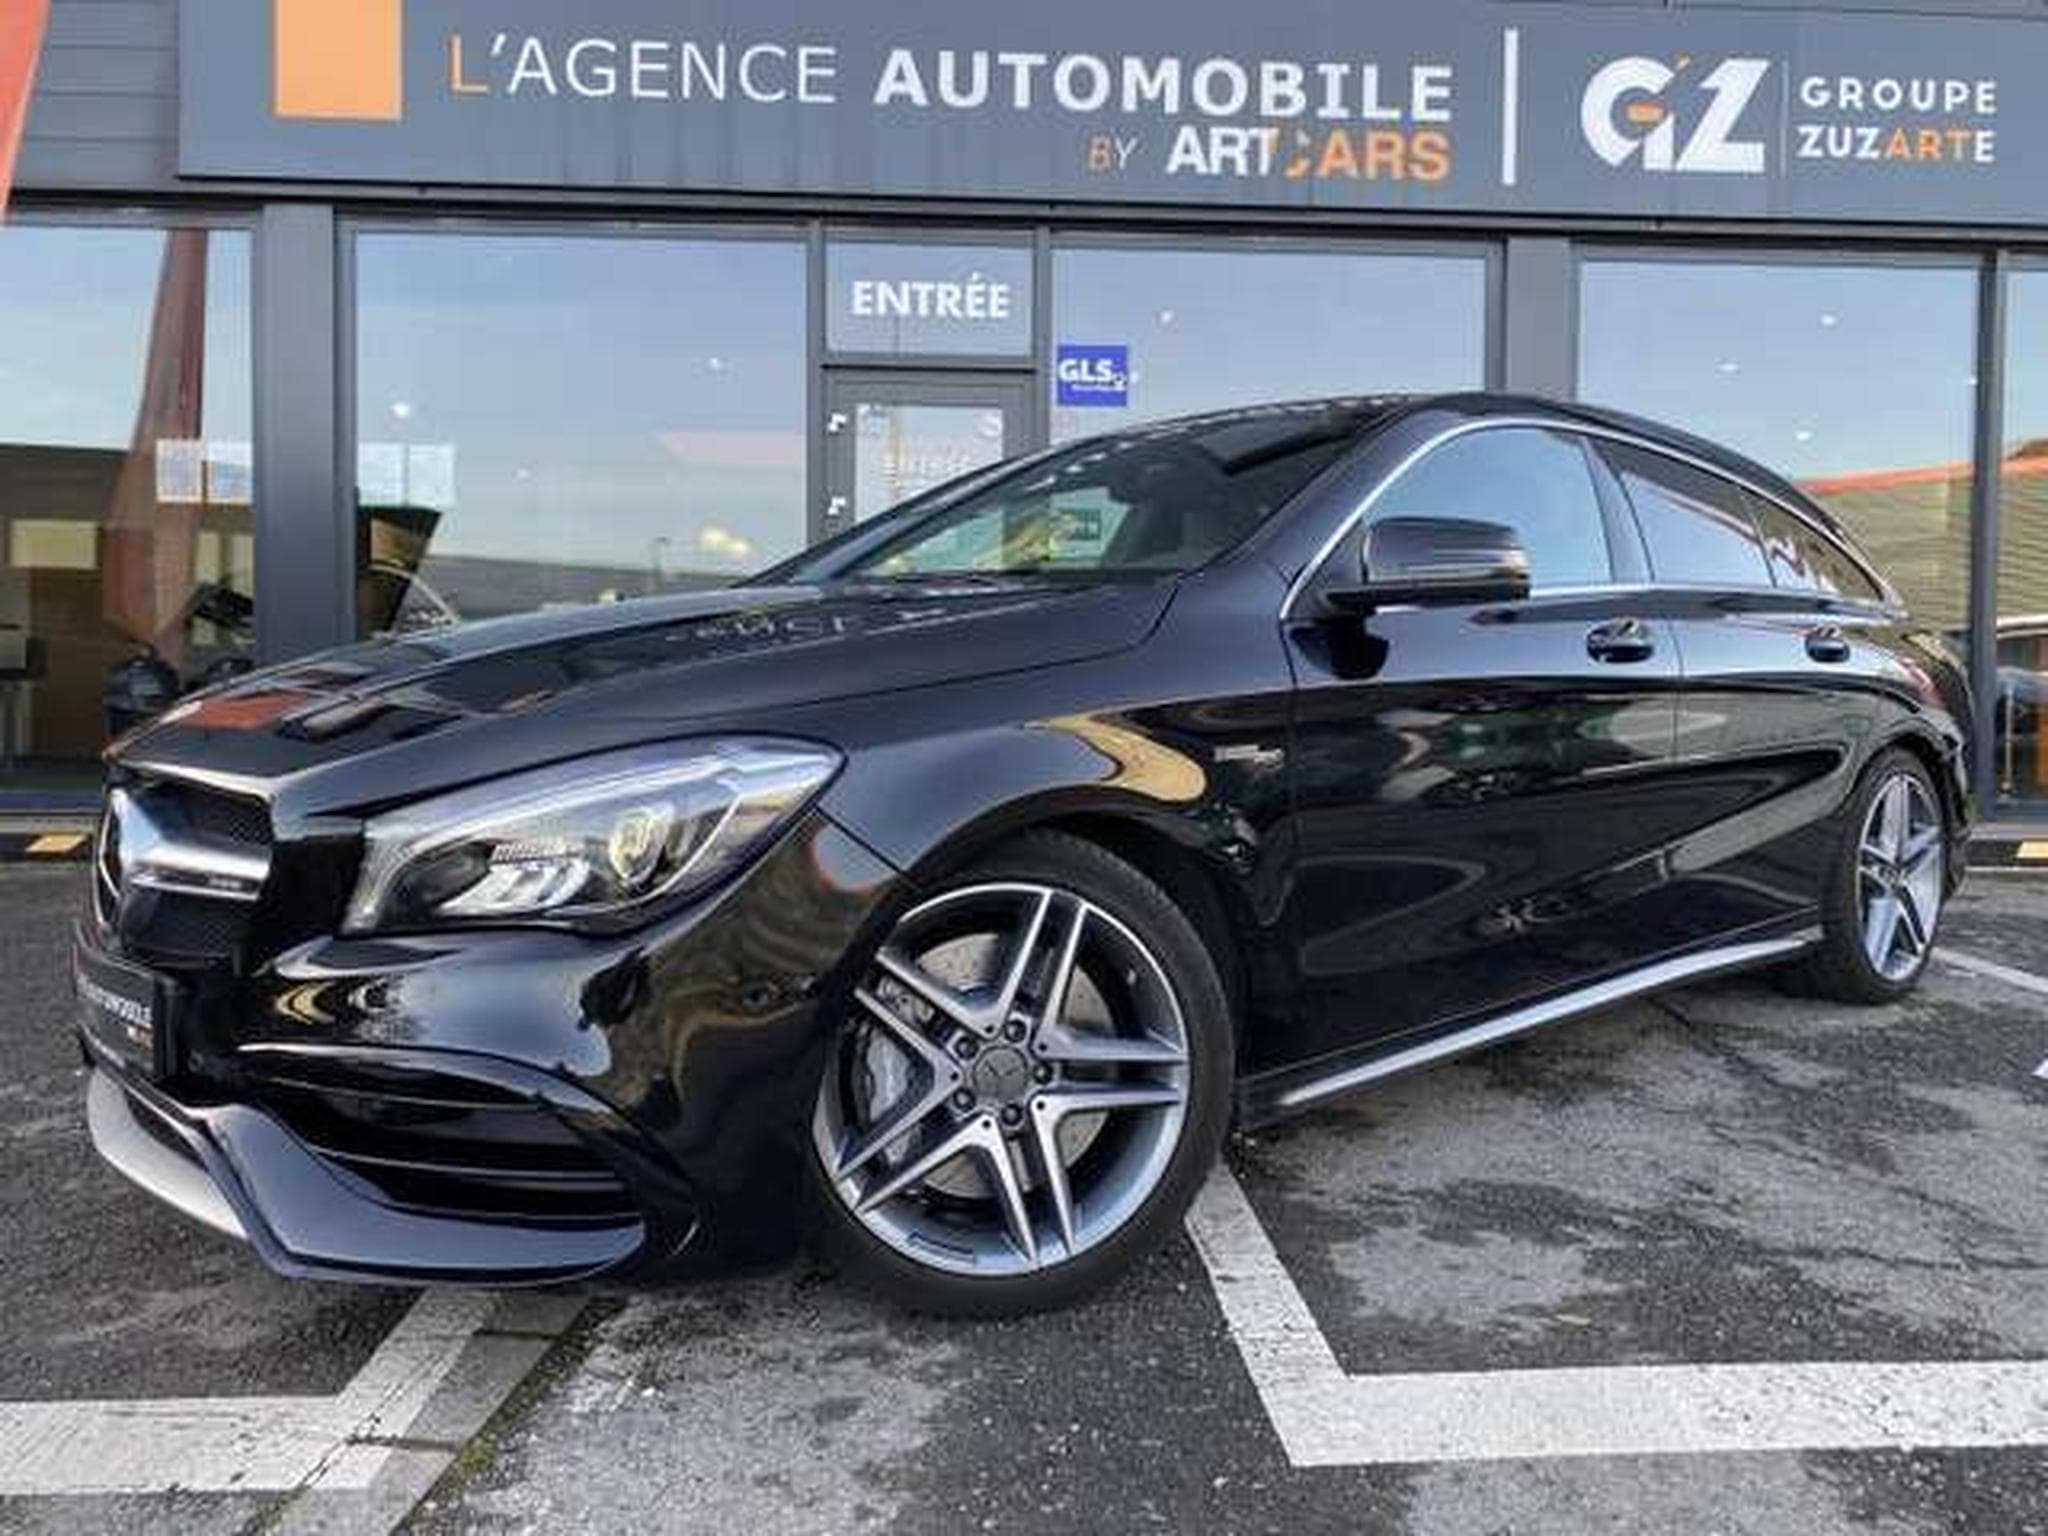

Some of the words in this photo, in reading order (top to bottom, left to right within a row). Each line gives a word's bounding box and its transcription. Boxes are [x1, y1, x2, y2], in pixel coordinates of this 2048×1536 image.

[873, 48, 1453, 122] AUTOMOBILE
[1800, 76, 1997, 114] GROUPE
[1088, 136, 1138, 173] BY
[1796, 124, 1997, 164] ZUZARTE
[851, 271, 1010, 319] ENTRÉE
